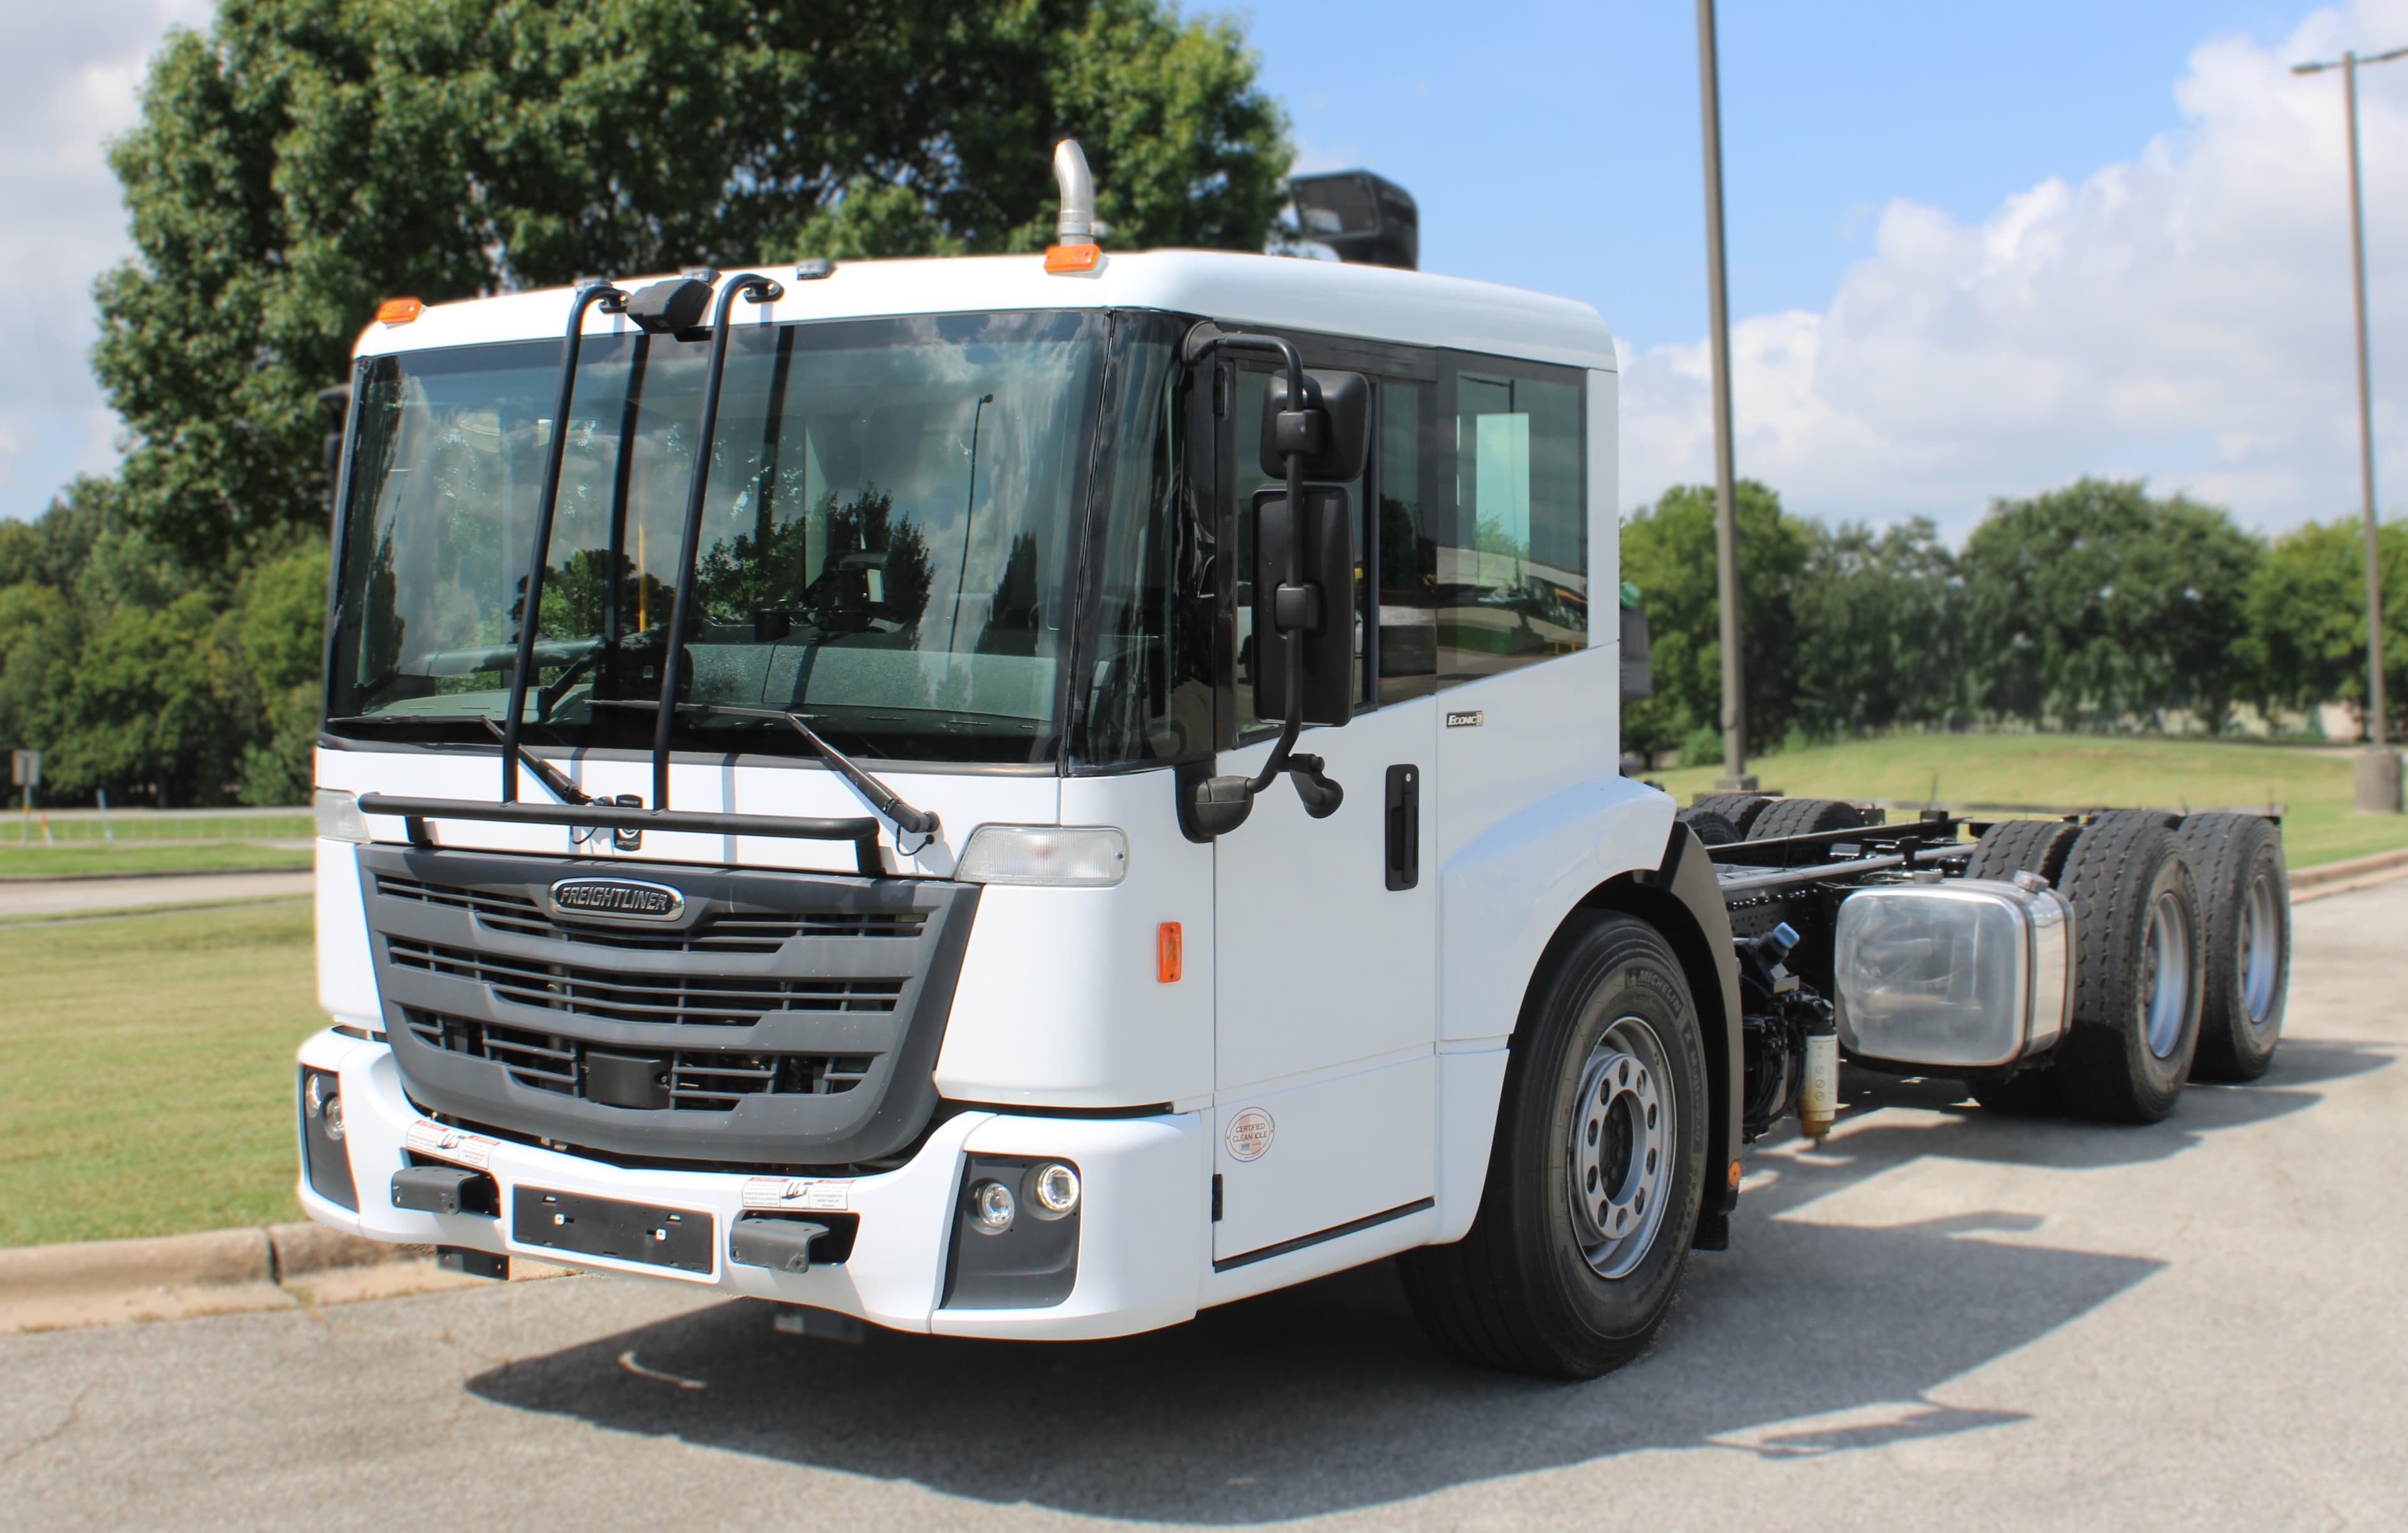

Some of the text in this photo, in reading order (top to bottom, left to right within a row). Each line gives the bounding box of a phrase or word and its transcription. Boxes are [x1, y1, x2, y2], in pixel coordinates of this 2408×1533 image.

[560, 887, 667, 910] FREIGHTLINER
[1639, 970, 1681, 1011] MICHELIN
[1236, 1123, 1265, 1133] CERTIFIED
[1233, 1133, 1252, 1142] CLEAN
